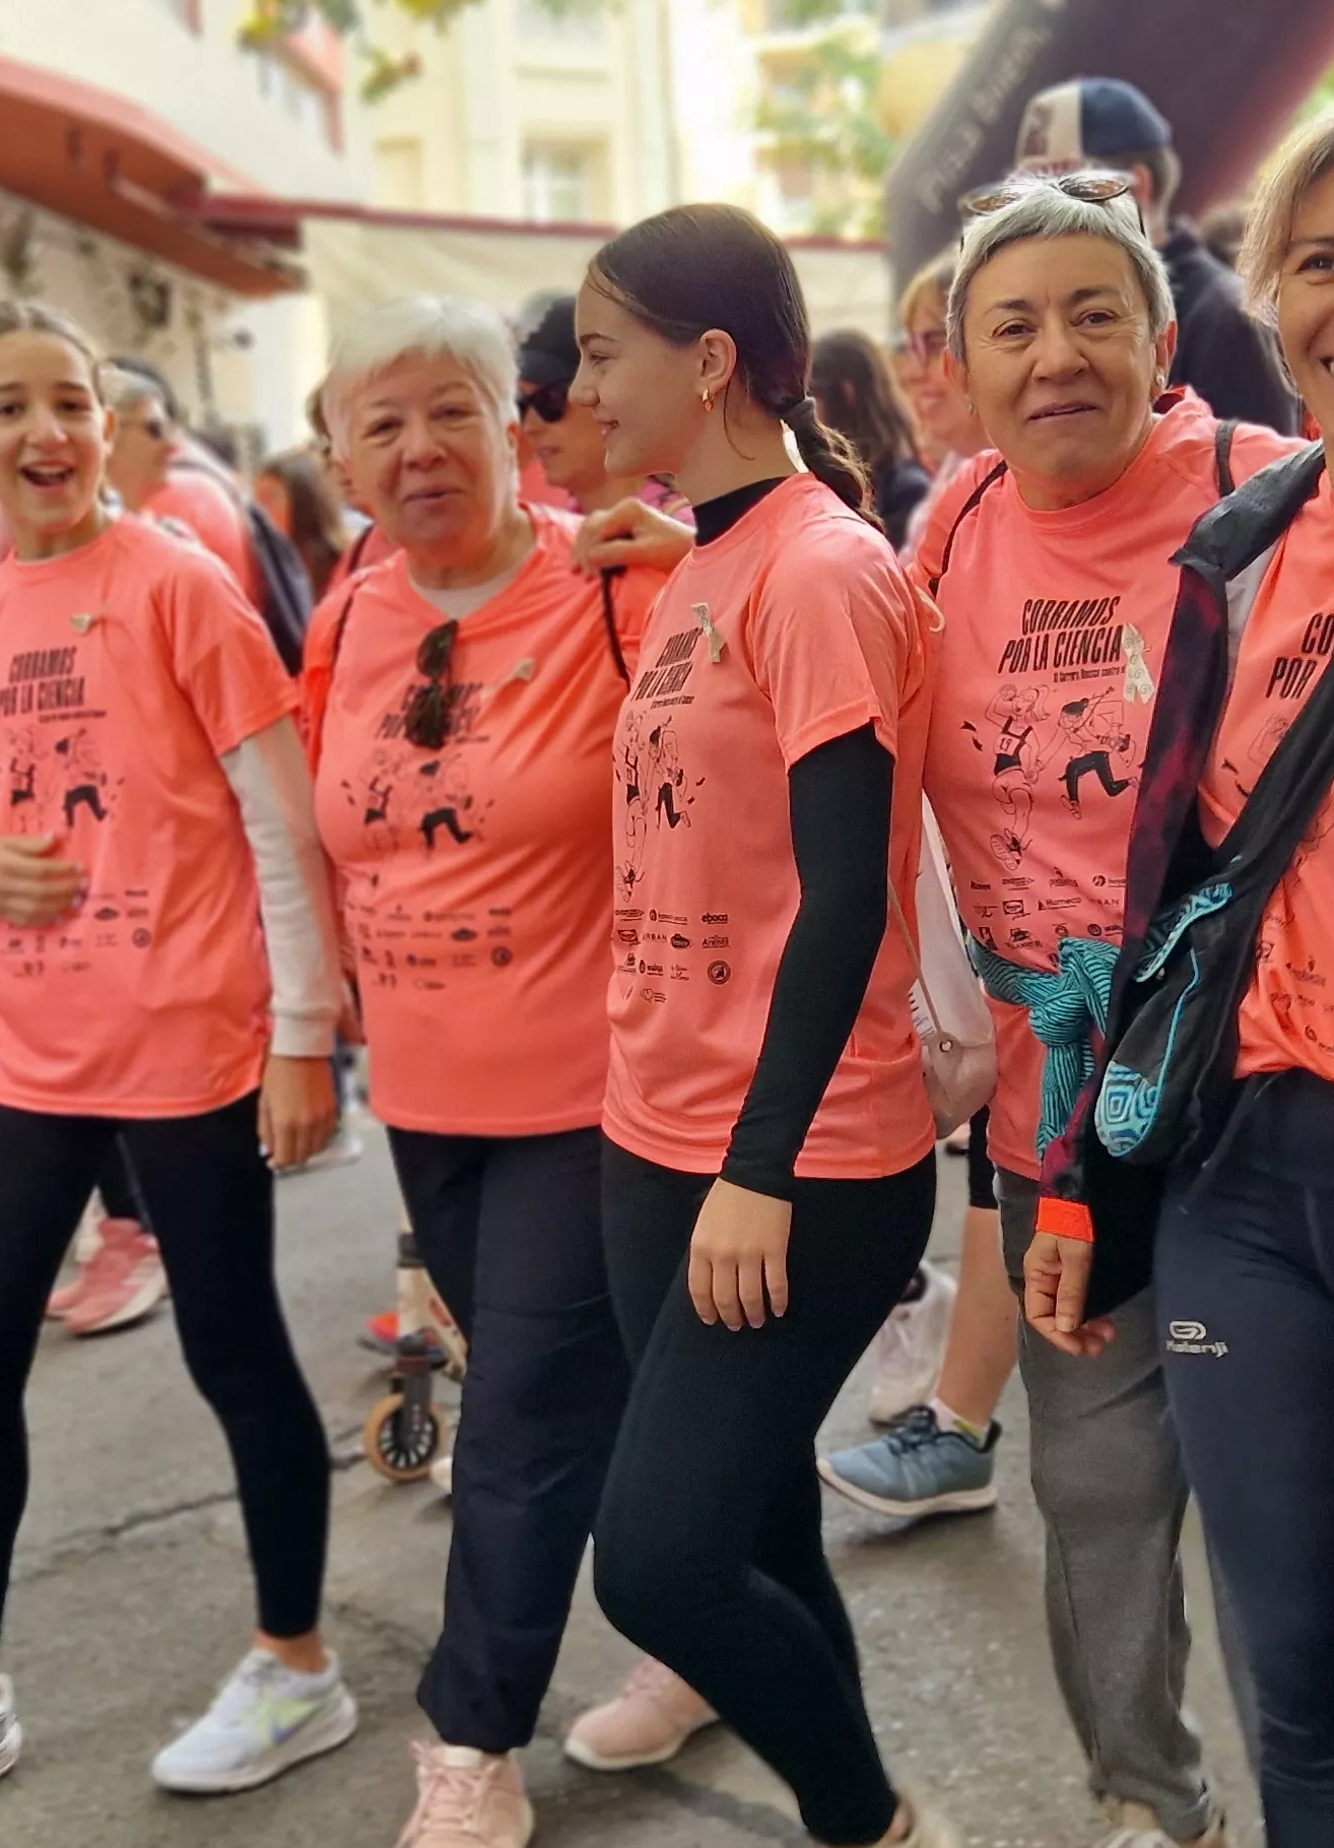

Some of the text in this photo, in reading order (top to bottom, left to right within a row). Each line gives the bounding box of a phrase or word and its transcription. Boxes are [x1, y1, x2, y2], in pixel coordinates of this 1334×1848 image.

[1022, 596, 1121, 635] CORRAMOS
[998, 625, 1123, 674] POR LA CIENCIA
[1265, 656, 1318, 700] POR
